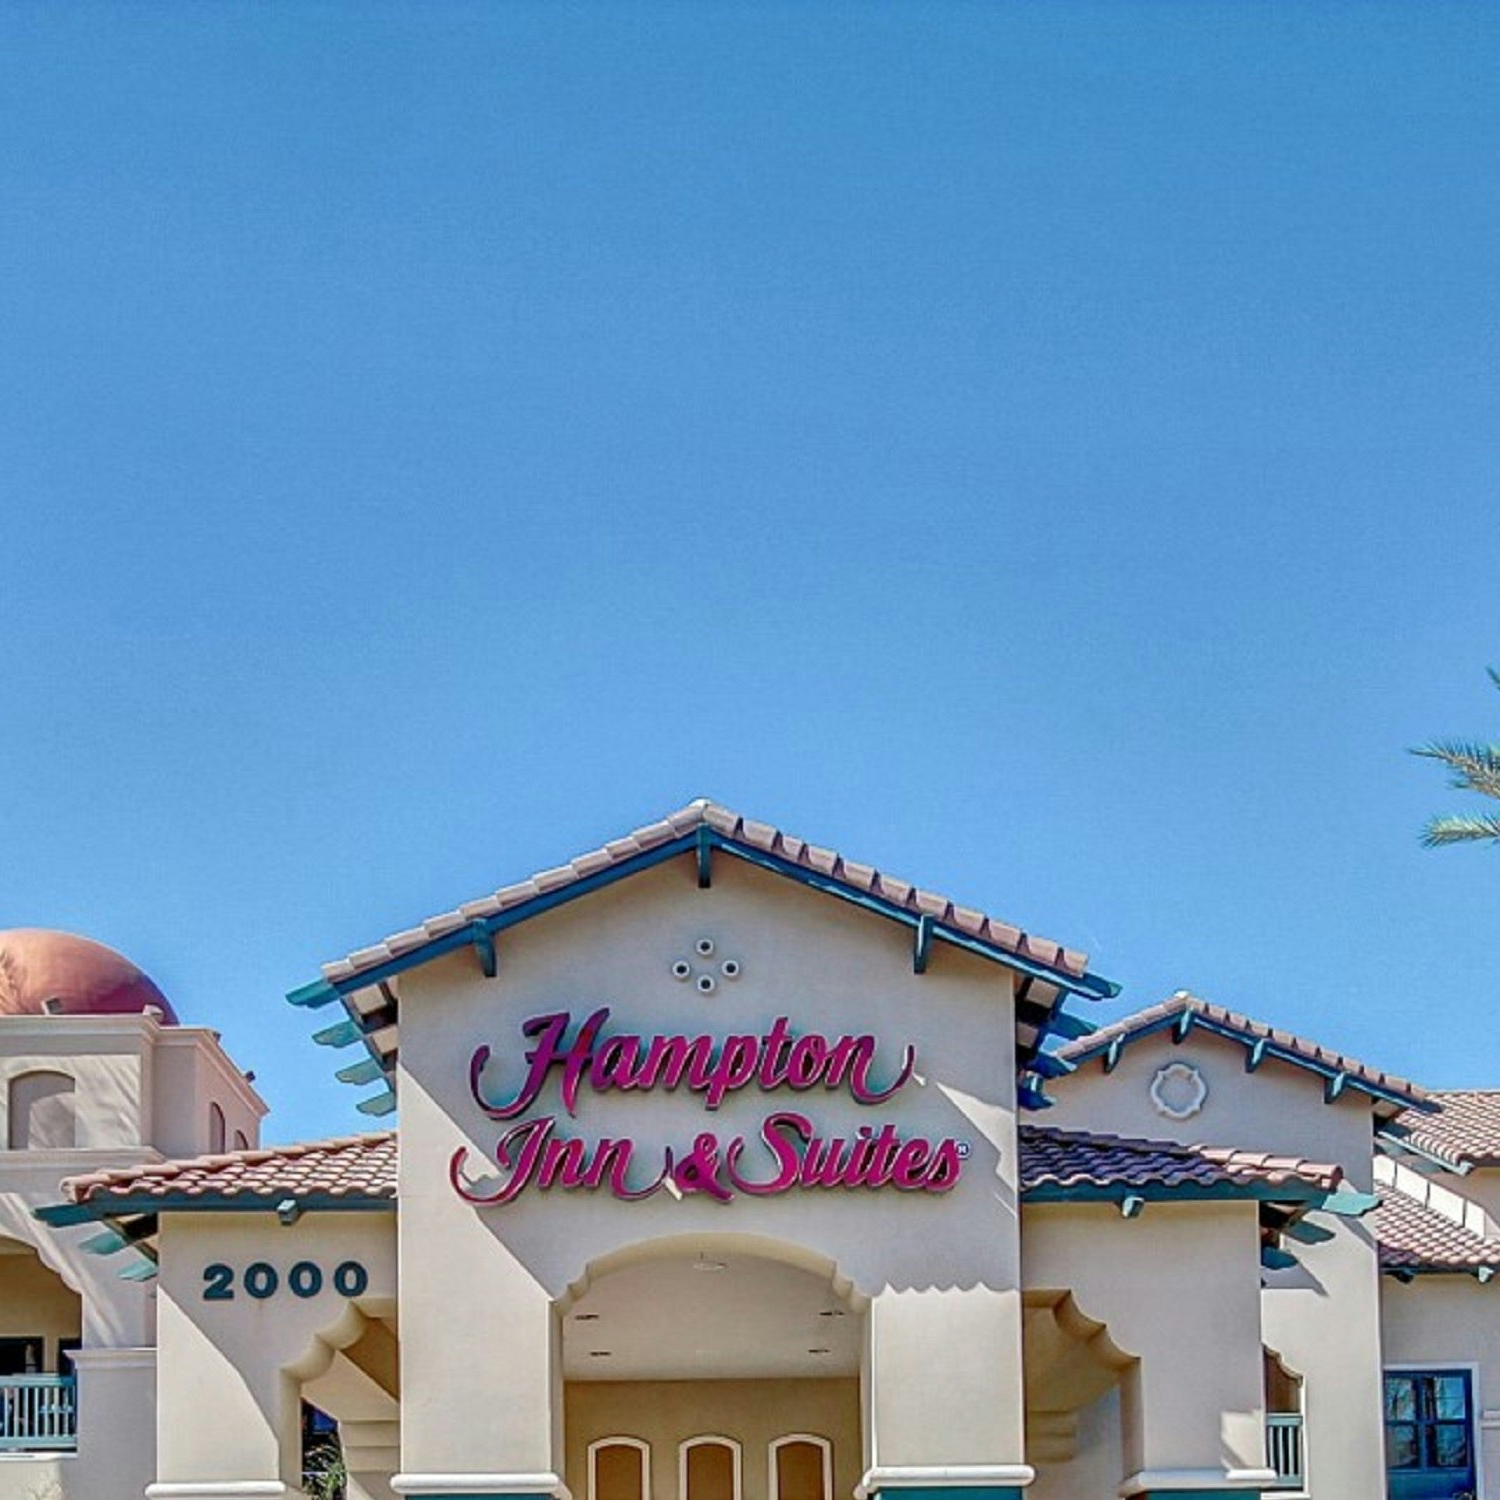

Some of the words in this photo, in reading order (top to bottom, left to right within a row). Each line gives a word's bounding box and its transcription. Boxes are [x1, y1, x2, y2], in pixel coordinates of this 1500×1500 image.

[469, 1007, 915, 1120] Hampton
[449, 1115, 674, 1206] Inn
[673, 1132, 736, 1205] &
[726, 1110, 961, 1196] Suites
[202, 1260, 368, 1301] 2000
